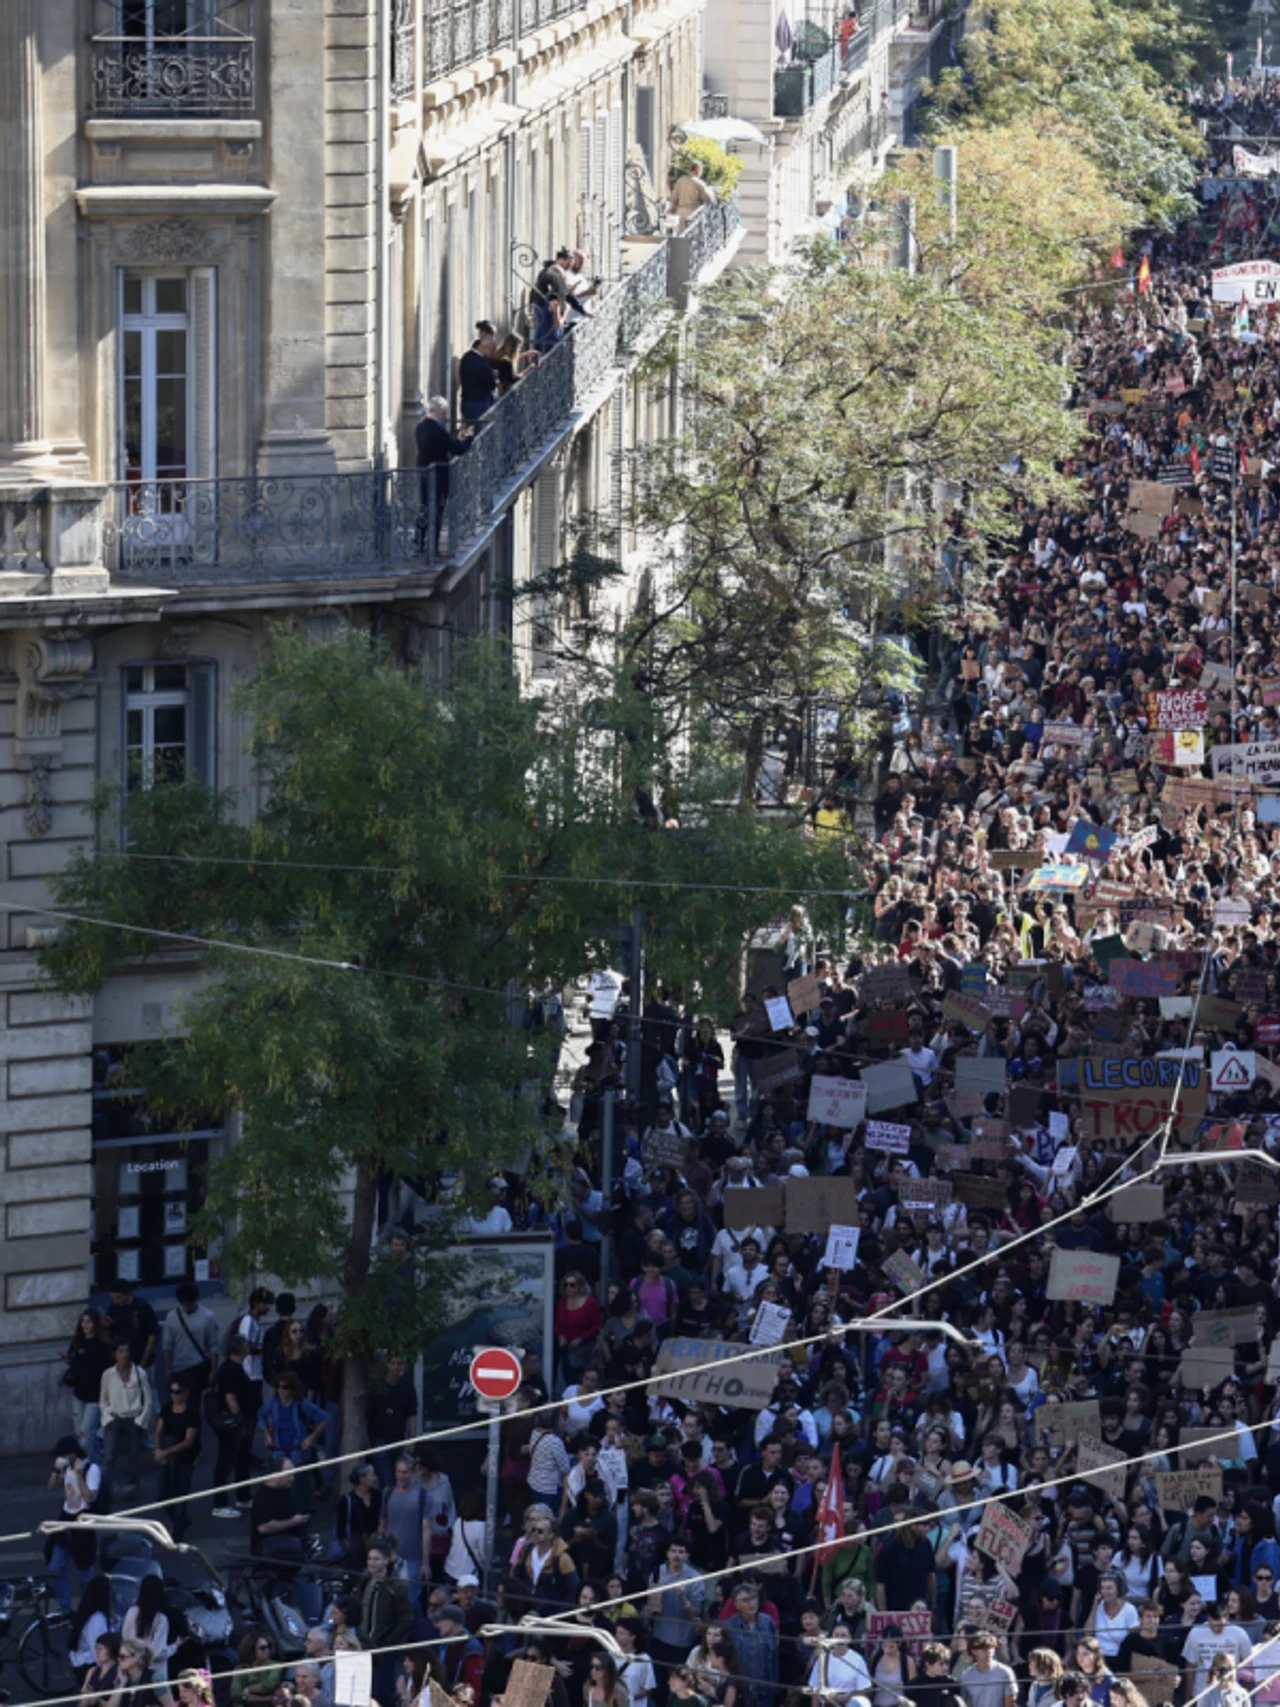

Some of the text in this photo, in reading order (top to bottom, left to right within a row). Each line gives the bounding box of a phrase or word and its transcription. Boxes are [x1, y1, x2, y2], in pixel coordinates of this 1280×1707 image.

[1255, 279, 1277, 298] EN
[1084, 1058, 1200, 1089] LECORNU
[1084, 1098, 1183, 1137] TROU
[127, 1160, 180, 1173] Location
